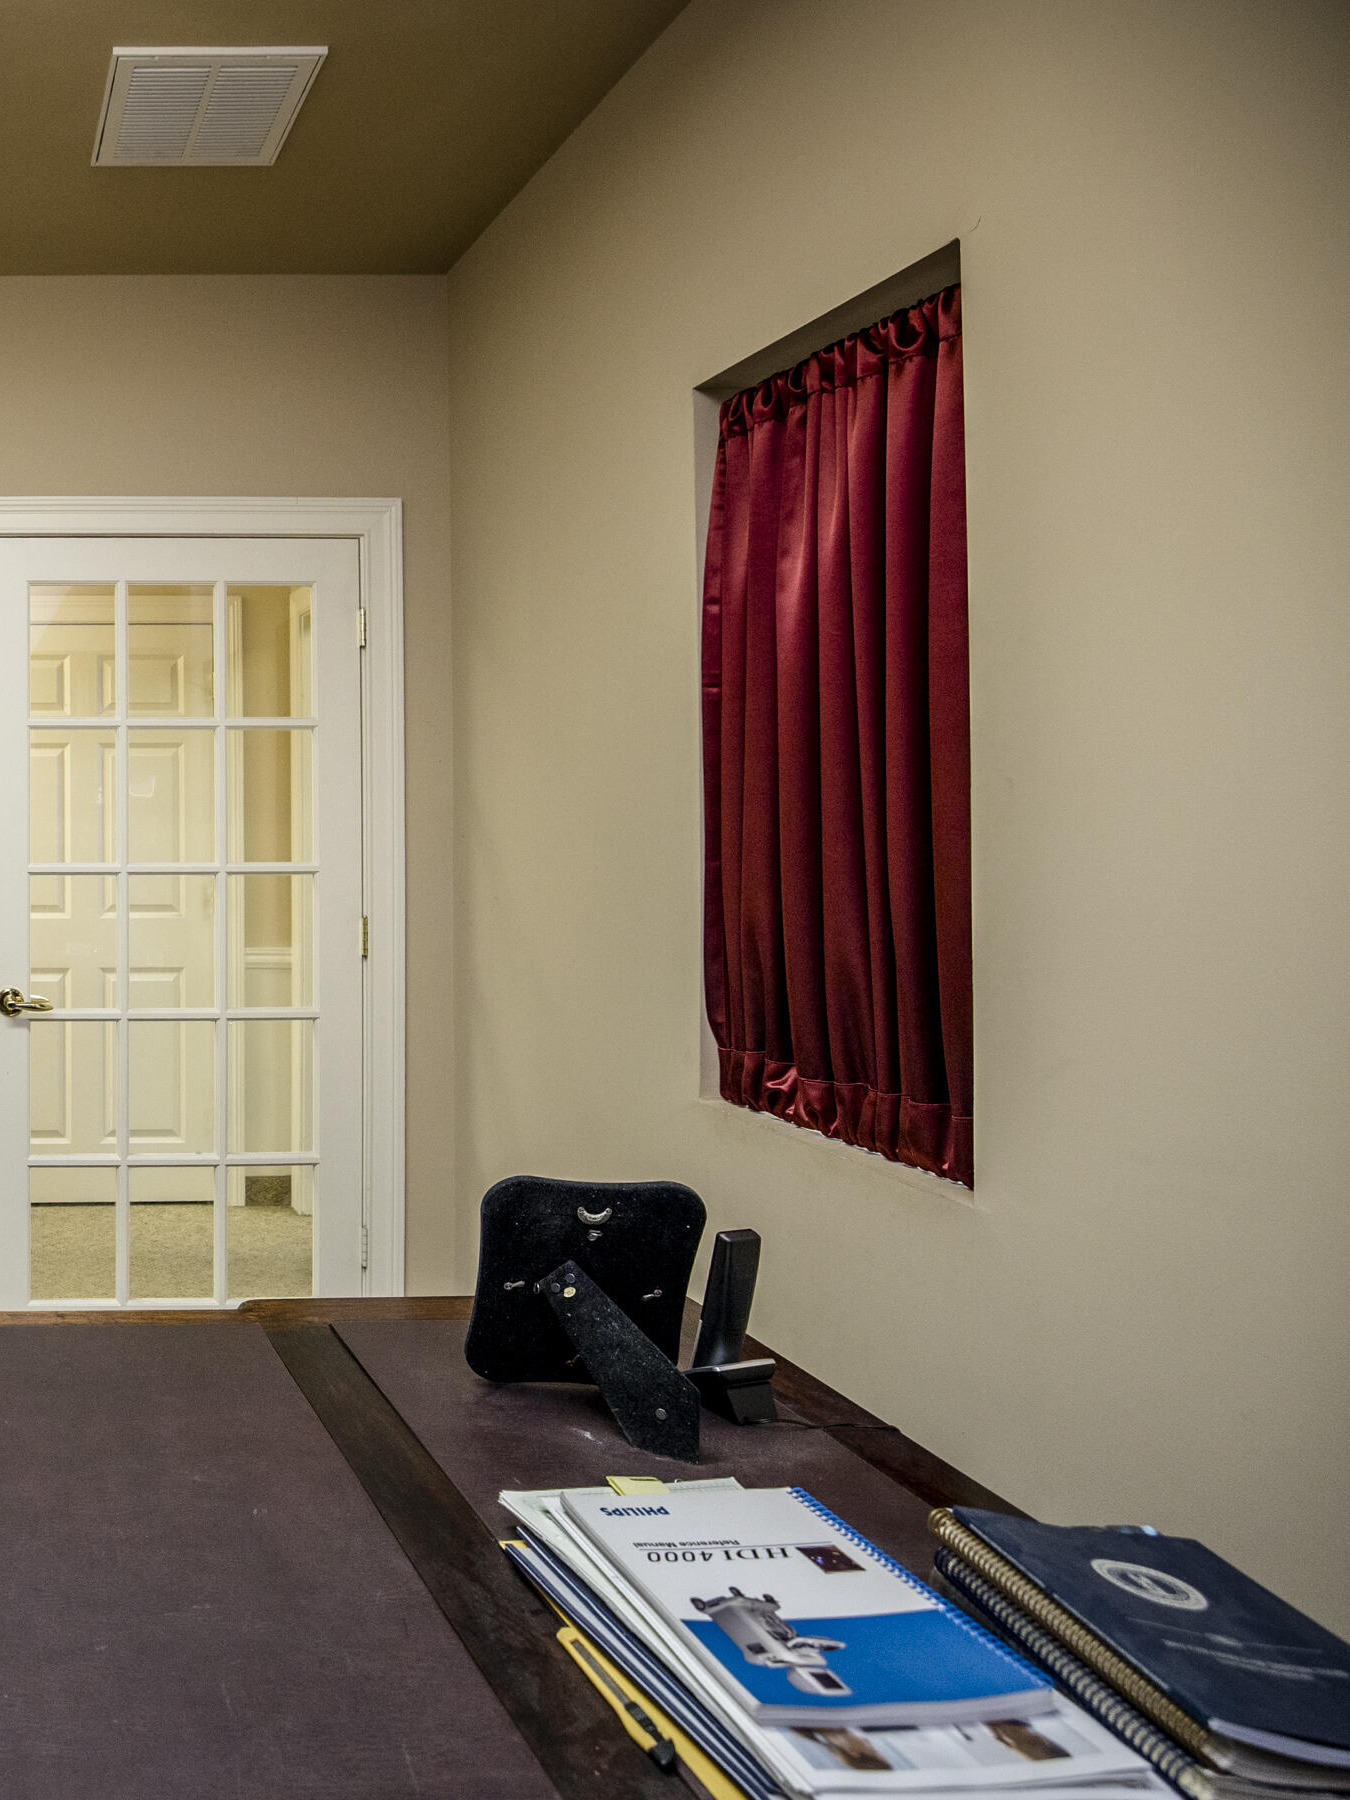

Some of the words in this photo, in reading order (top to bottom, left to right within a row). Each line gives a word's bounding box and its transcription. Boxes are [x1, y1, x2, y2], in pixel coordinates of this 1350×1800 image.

[600, 1506, 670, 1517] PHILIPS
[679, 1539, 741, 1547] Reference
[647, 1550, 713, 1563] 4000
[724, 1547, 792, 1561] HDI
